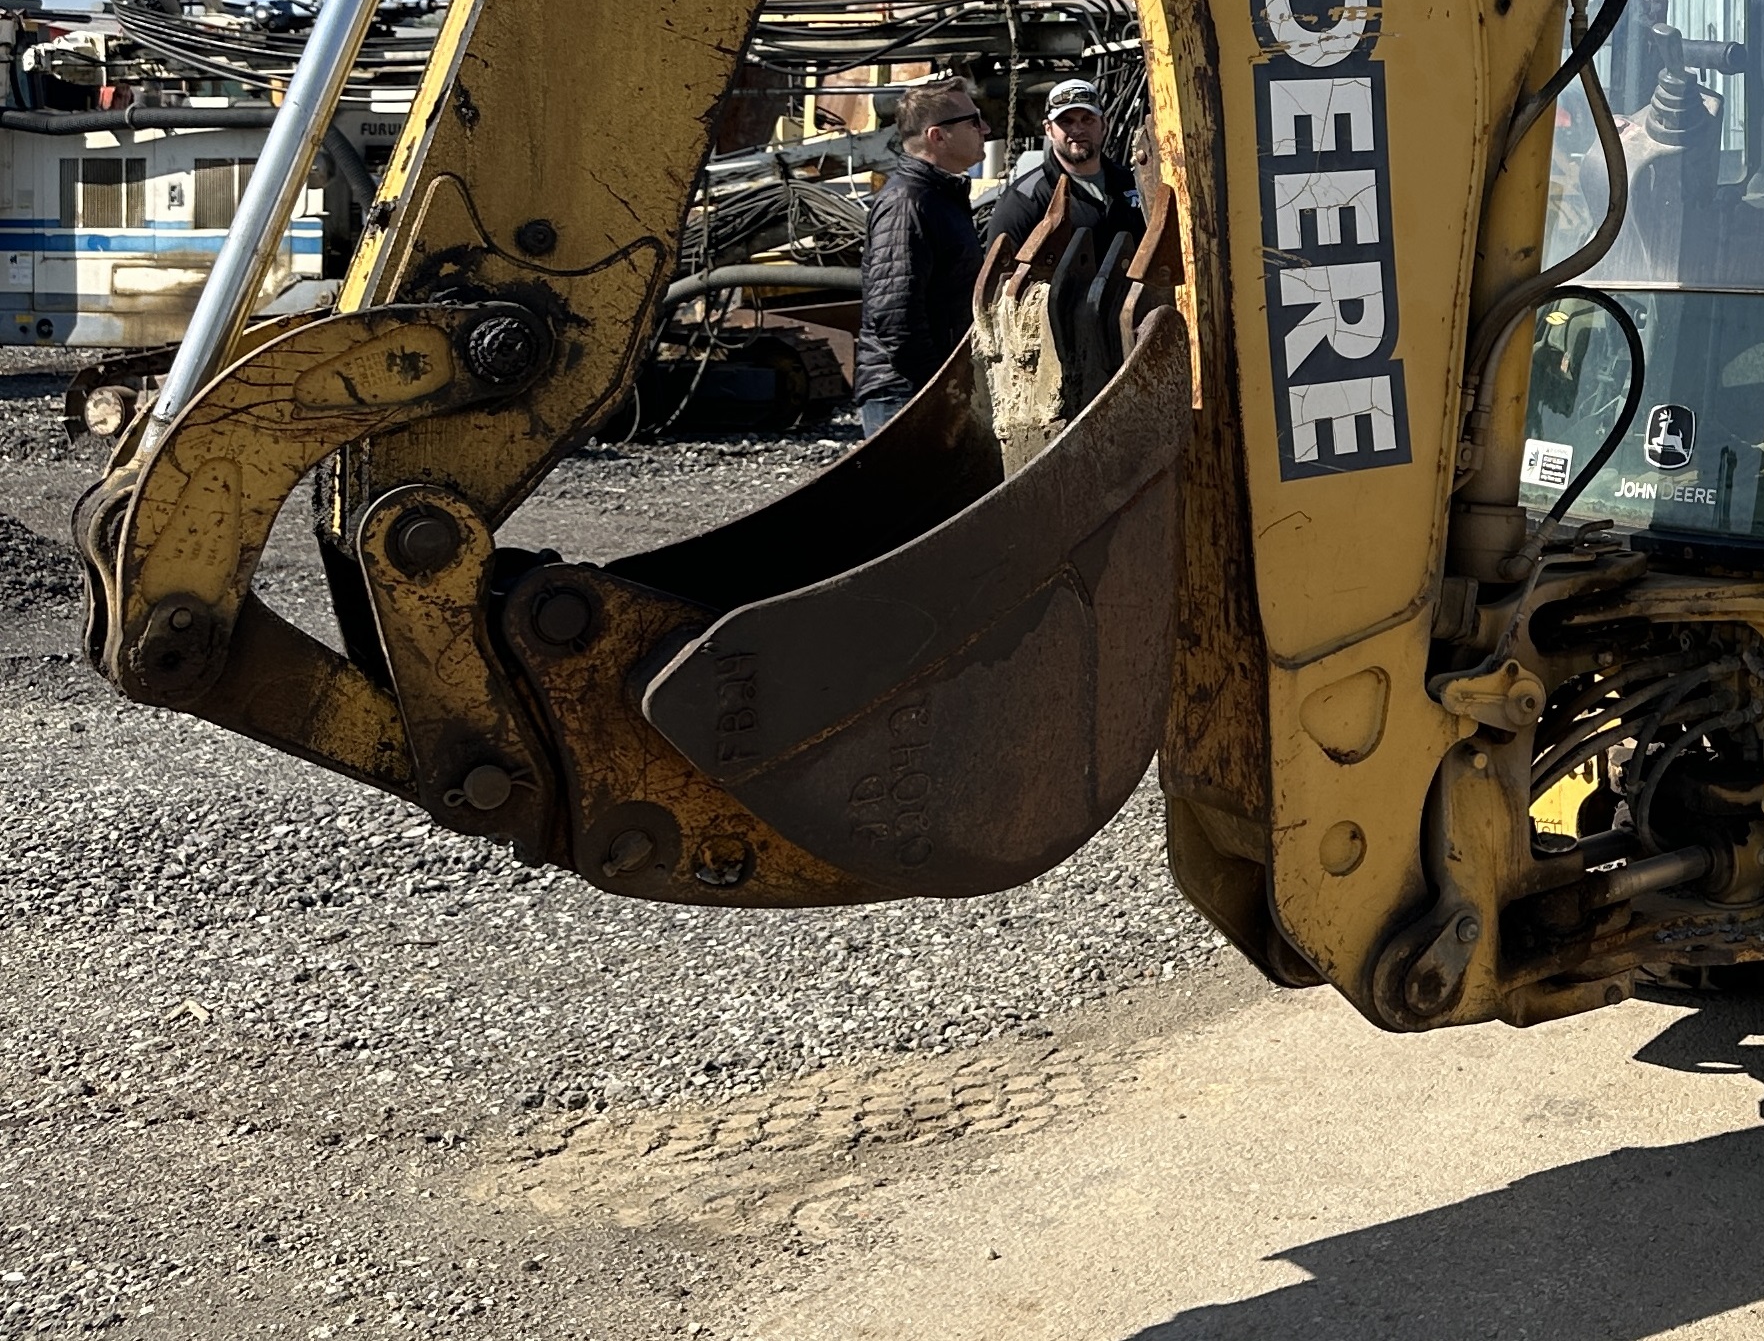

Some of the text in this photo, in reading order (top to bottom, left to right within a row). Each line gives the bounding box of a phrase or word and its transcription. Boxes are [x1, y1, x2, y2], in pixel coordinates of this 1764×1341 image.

[360, 122, 402, 136] FURU
[1614, 477, 1718, 505] JOHN DEERE
